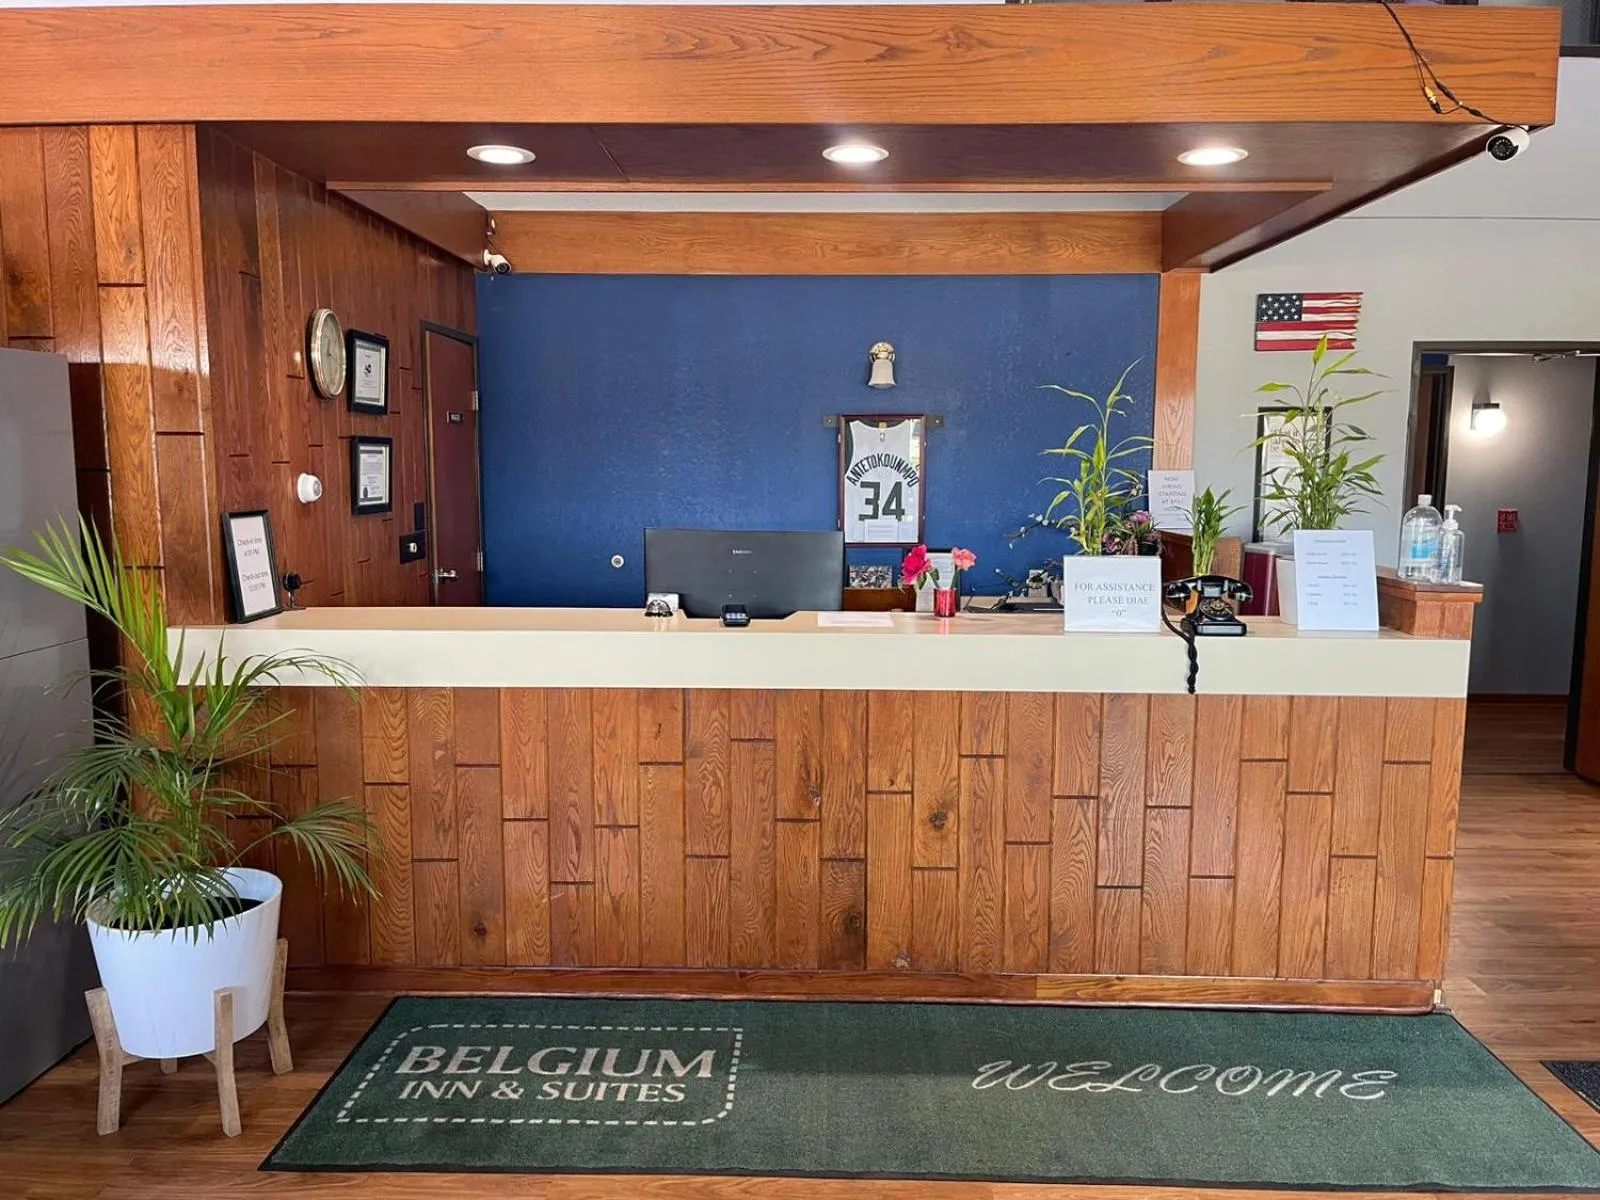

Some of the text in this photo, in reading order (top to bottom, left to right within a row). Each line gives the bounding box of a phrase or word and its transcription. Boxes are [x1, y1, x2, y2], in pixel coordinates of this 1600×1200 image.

[846, 453, 920, 488] ANTETOKOUNMPO
[858, 481, 905, 521] 34
[1075, 582, 1156, 591] FOR ASSISTANCE
[1088, 596, 1150, 604] PLEASE DIAL
[395, 1045, 716, 1078] BELGIUM
[399, 1080, 686, 1103] INN & SUITES
[971, 1060, 1397, 1099] WELCOME
